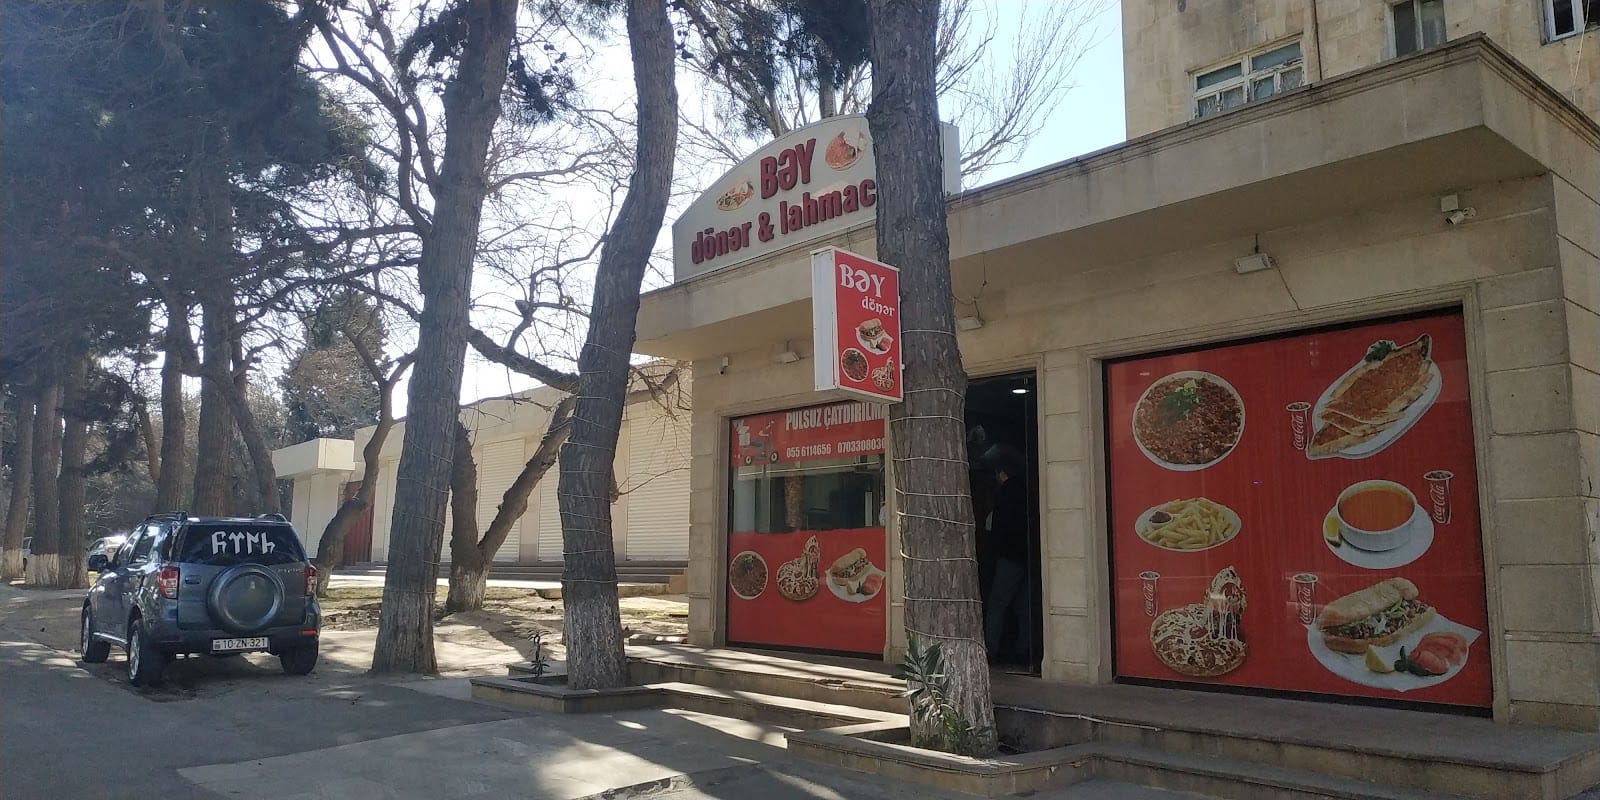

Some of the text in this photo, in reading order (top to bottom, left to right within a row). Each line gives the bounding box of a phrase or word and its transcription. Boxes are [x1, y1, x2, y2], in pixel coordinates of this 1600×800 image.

[758, 211, 775, 242] &
[779, 178, 877, 235] lahmac
[785, 409, 822, 431] PULSUZ
[786, 447, 800, 458] 055
[801, 443, 832, 457] 6114656
